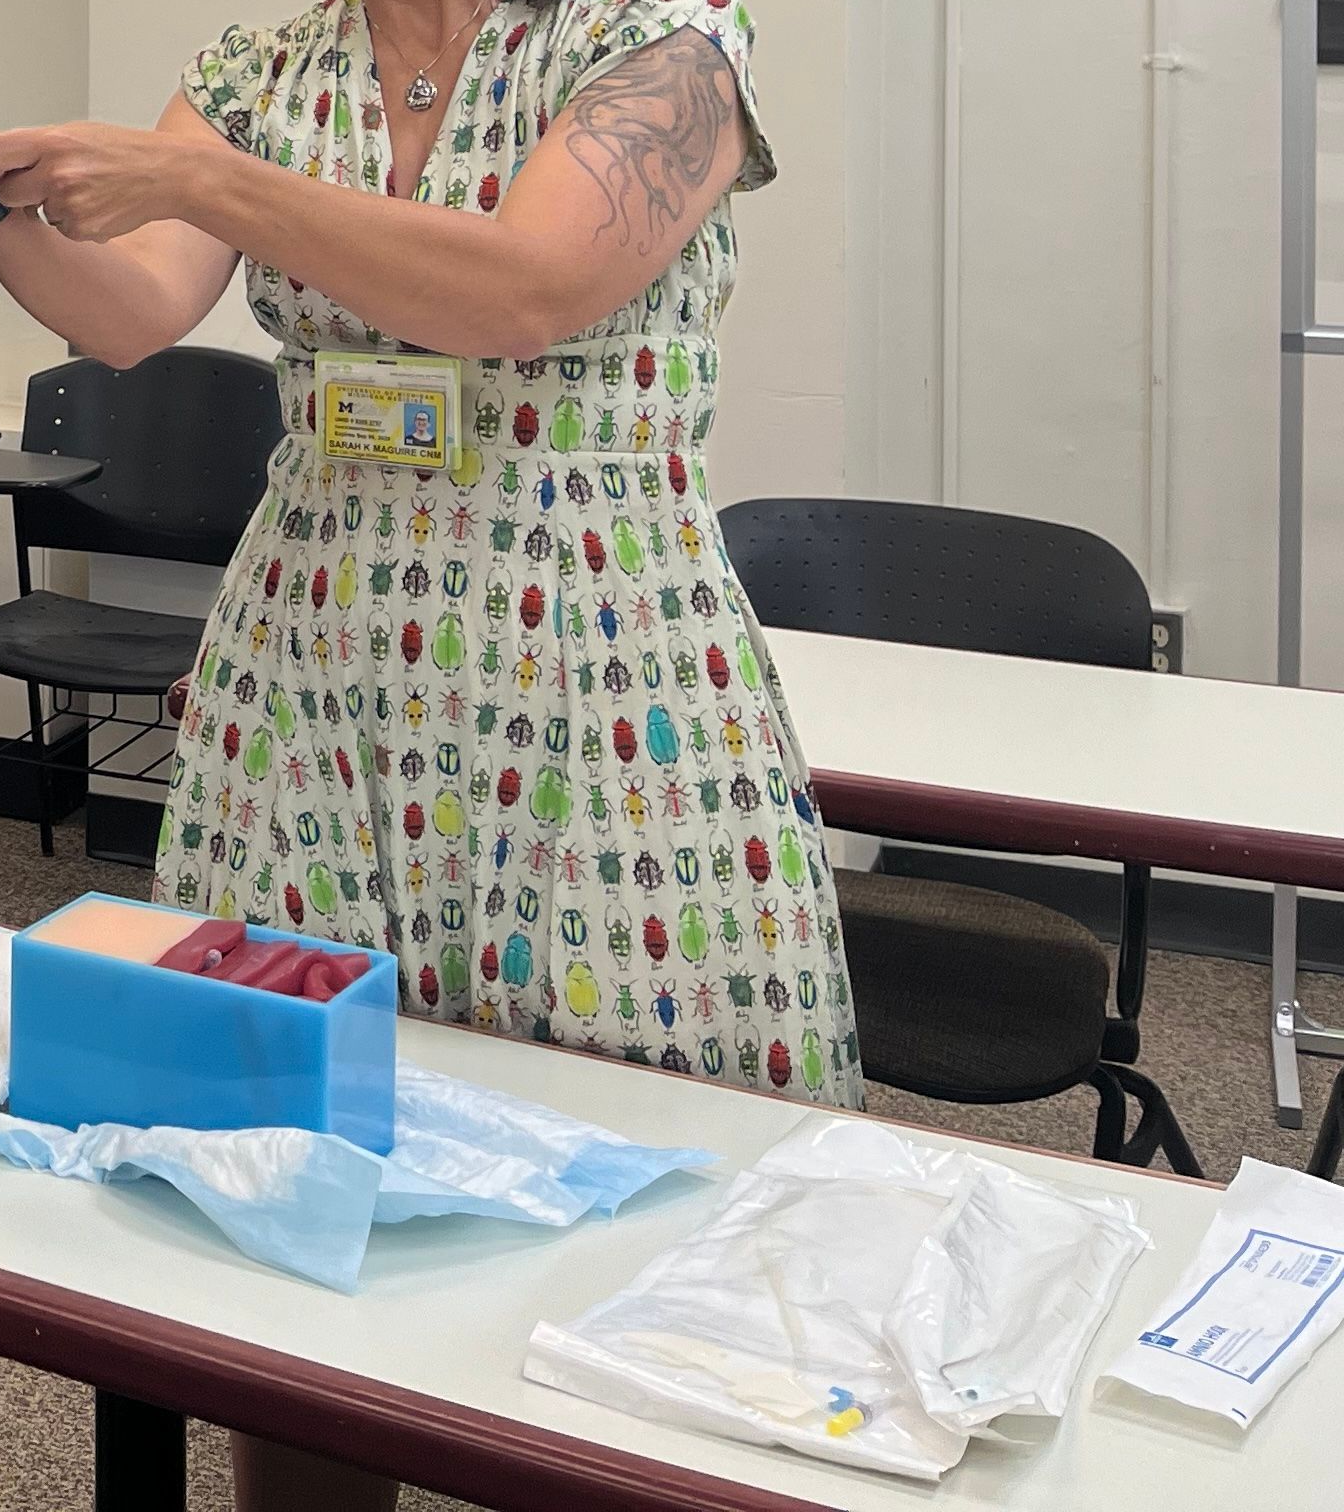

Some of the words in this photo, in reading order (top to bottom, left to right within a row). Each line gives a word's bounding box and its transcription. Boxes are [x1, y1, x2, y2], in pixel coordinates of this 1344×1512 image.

[338, 401, 353, 413] M
[329, 439, 361, 451] SARAH
[363, 443, 371, 452] K
[373, 444, 417, 457] MAGUIRE
[419, 449, 442, 459] CNM
